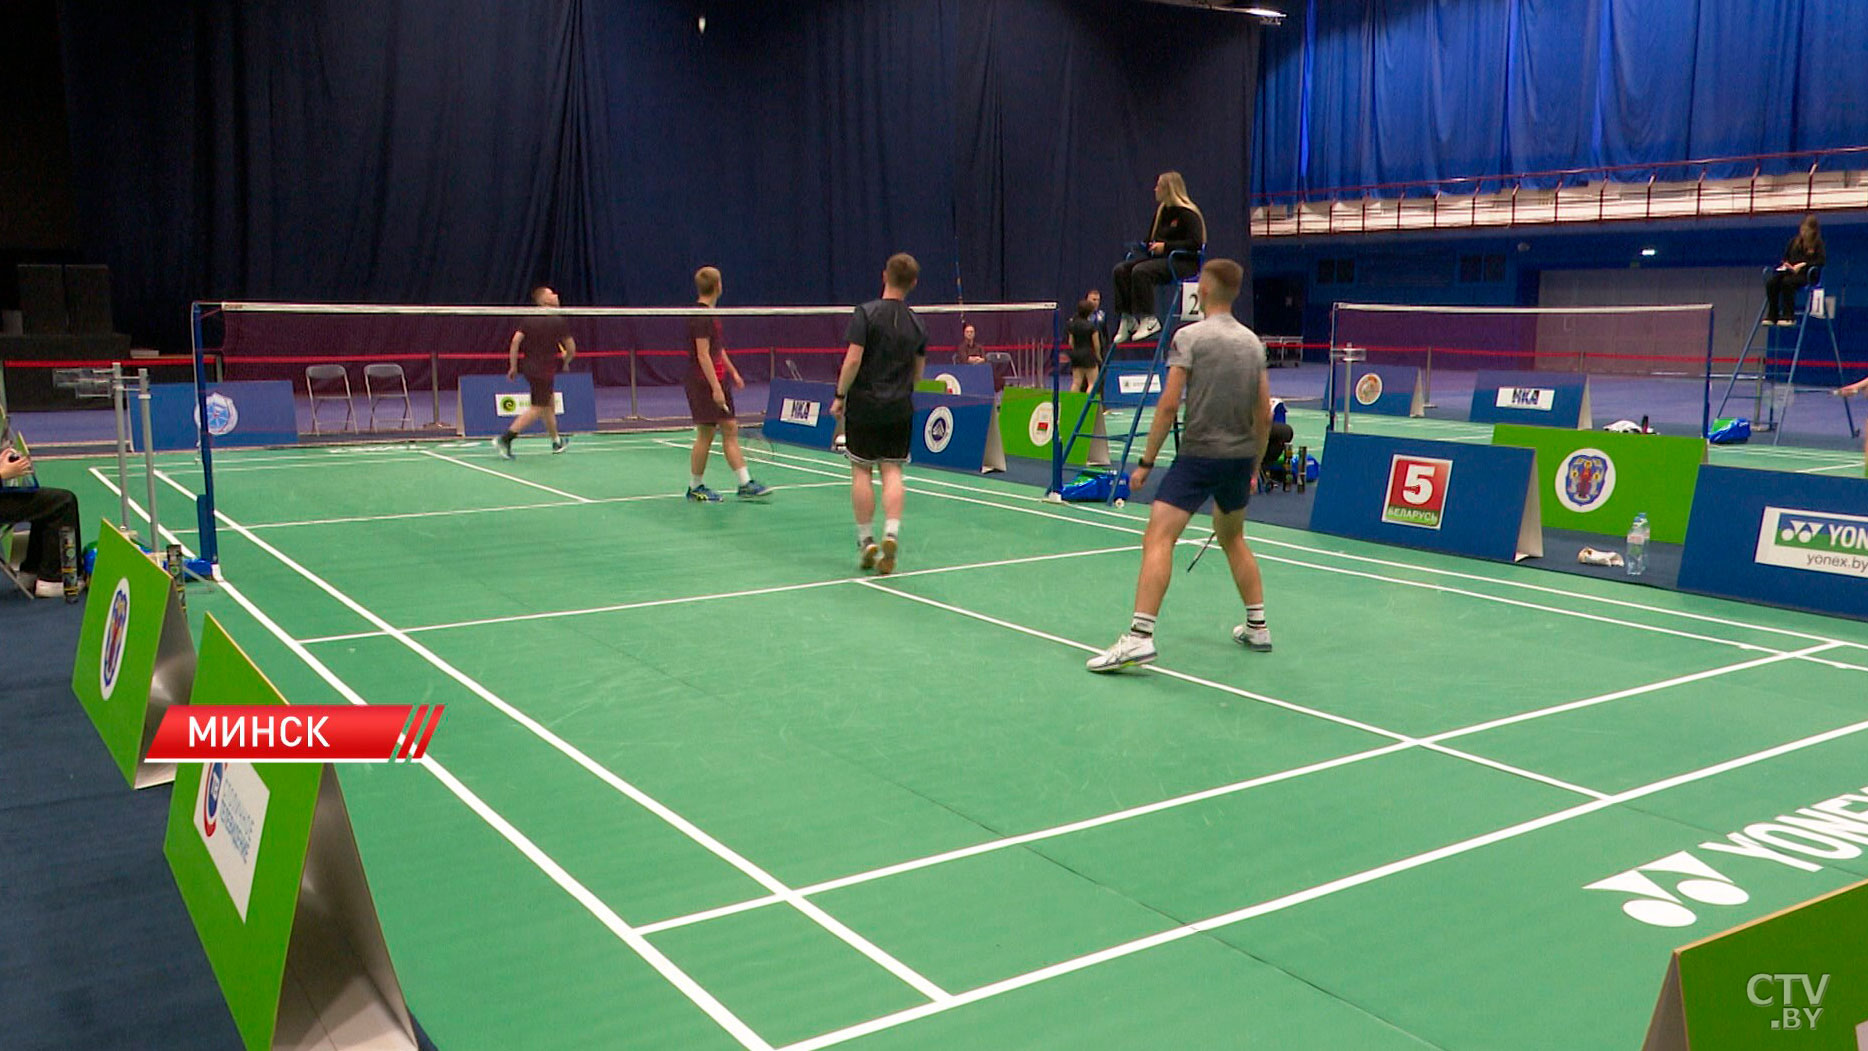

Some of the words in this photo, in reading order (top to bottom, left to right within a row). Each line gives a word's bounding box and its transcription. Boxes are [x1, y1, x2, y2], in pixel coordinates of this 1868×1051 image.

[1189, 293, 1199, 315] 2
[1402, 464, 1436, 506] 5
[1387, 506, 1438, 525] БЕЛАРУСЬ
[1807, 554, 1868, 573] yonex.by
